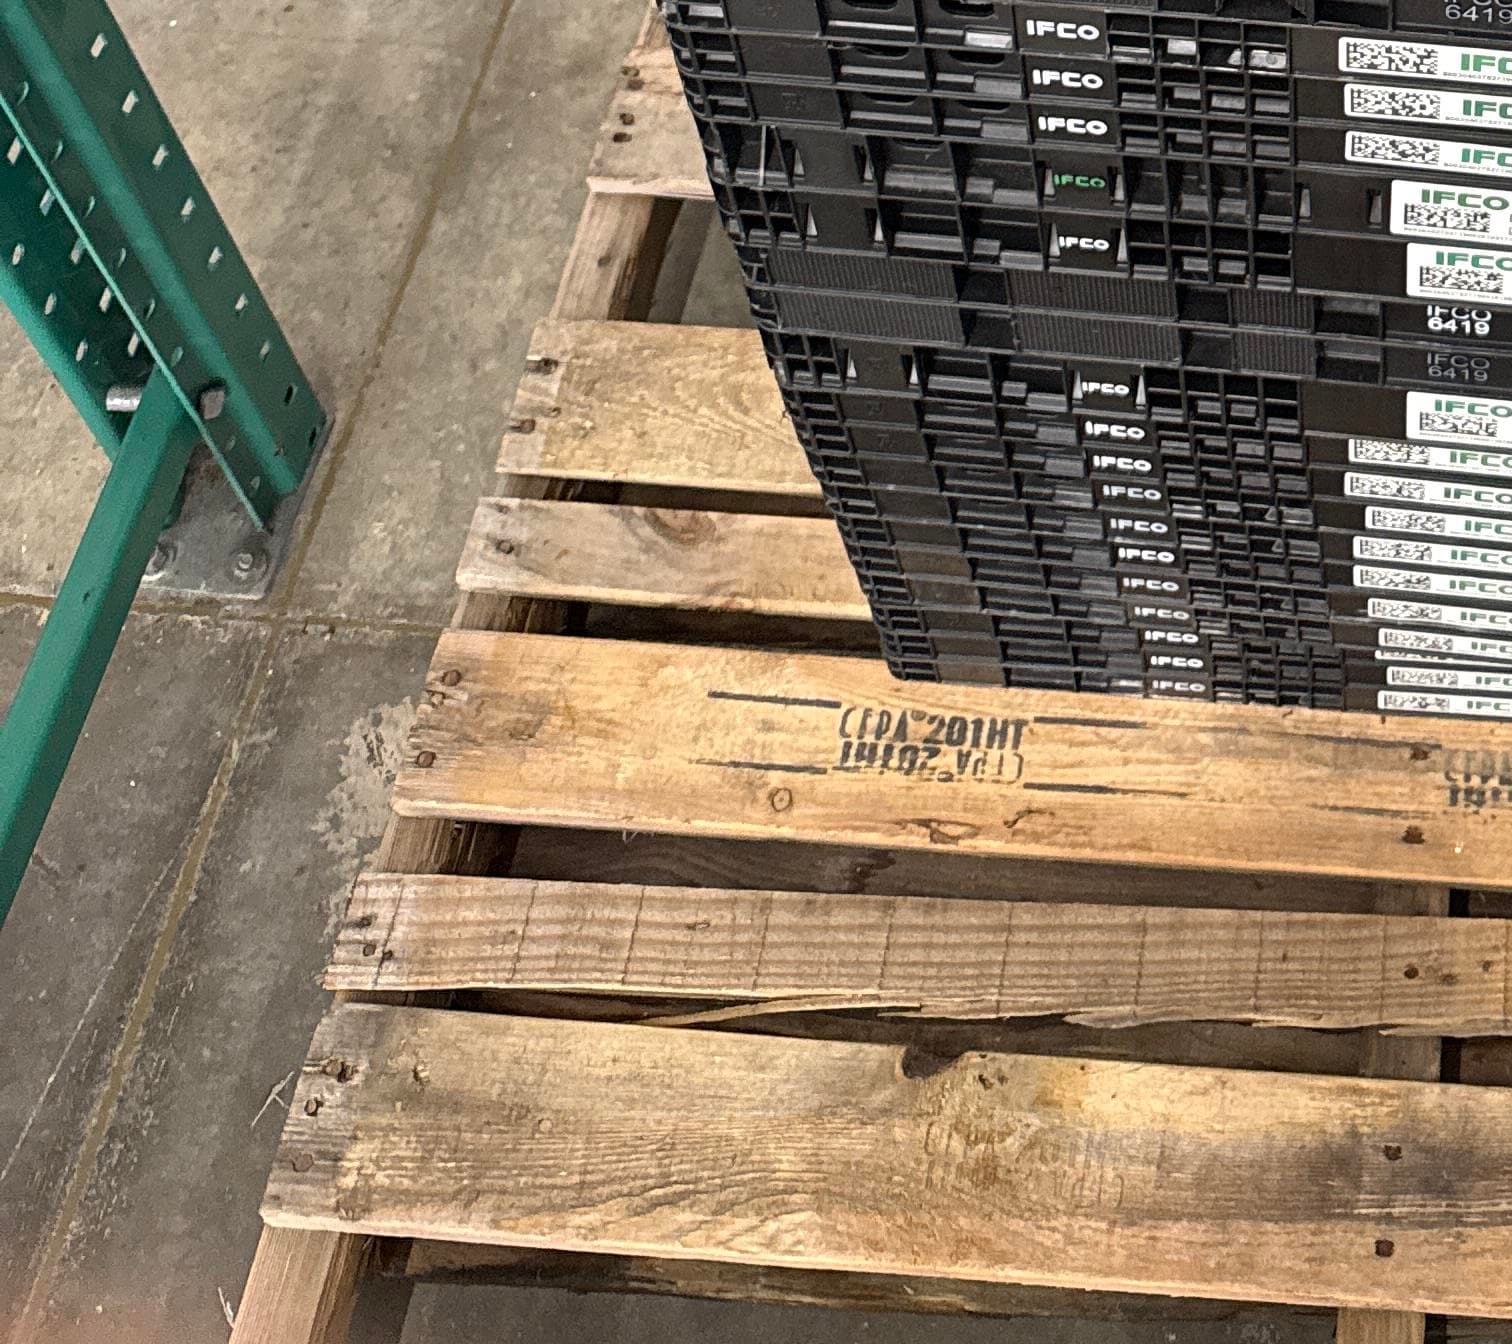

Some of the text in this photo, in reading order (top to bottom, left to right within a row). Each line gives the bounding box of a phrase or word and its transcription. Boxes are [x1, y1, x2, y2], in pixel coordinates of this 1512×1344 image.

[1026, 19, 1100, 40] IFCO
[1032, 69, 1103, 89] IFCO
[1038, 116, 1108, 135] IFCO
[1053, 174, 1106, 188] IFCO
[1421, 189, 1510, 211] IFCO
[1058, 235, 1110, 251] IFCO
[1427, 305, 1492, 322] IFCO
[1427, 316, 1490, 335] 6419
[1427, 352, 1490, 369] IFCO
[1428, 365, 1489, 381] 6419
[1082, 381, 1130, 396] IFCO
[1085, 420, 1145, 440] IFCO
[1093, 455, 1152, 472] IFCO
[1103, 484, 1162, 500] IFCO
[1110, 518, 1168, 534] IFCO
[1118, 547, 1175, 563] IFCO
[1122, 577, 1179, 592] IFCO
[1134, 606, 1190, 620] IFCO
[1144, 630, 1199, 644] IFCO
[1150, 655, 1204, 669] IFCO
[1152, 680, 1206, 693] IFCO
[922, 714, 1029, 750] 201HT
